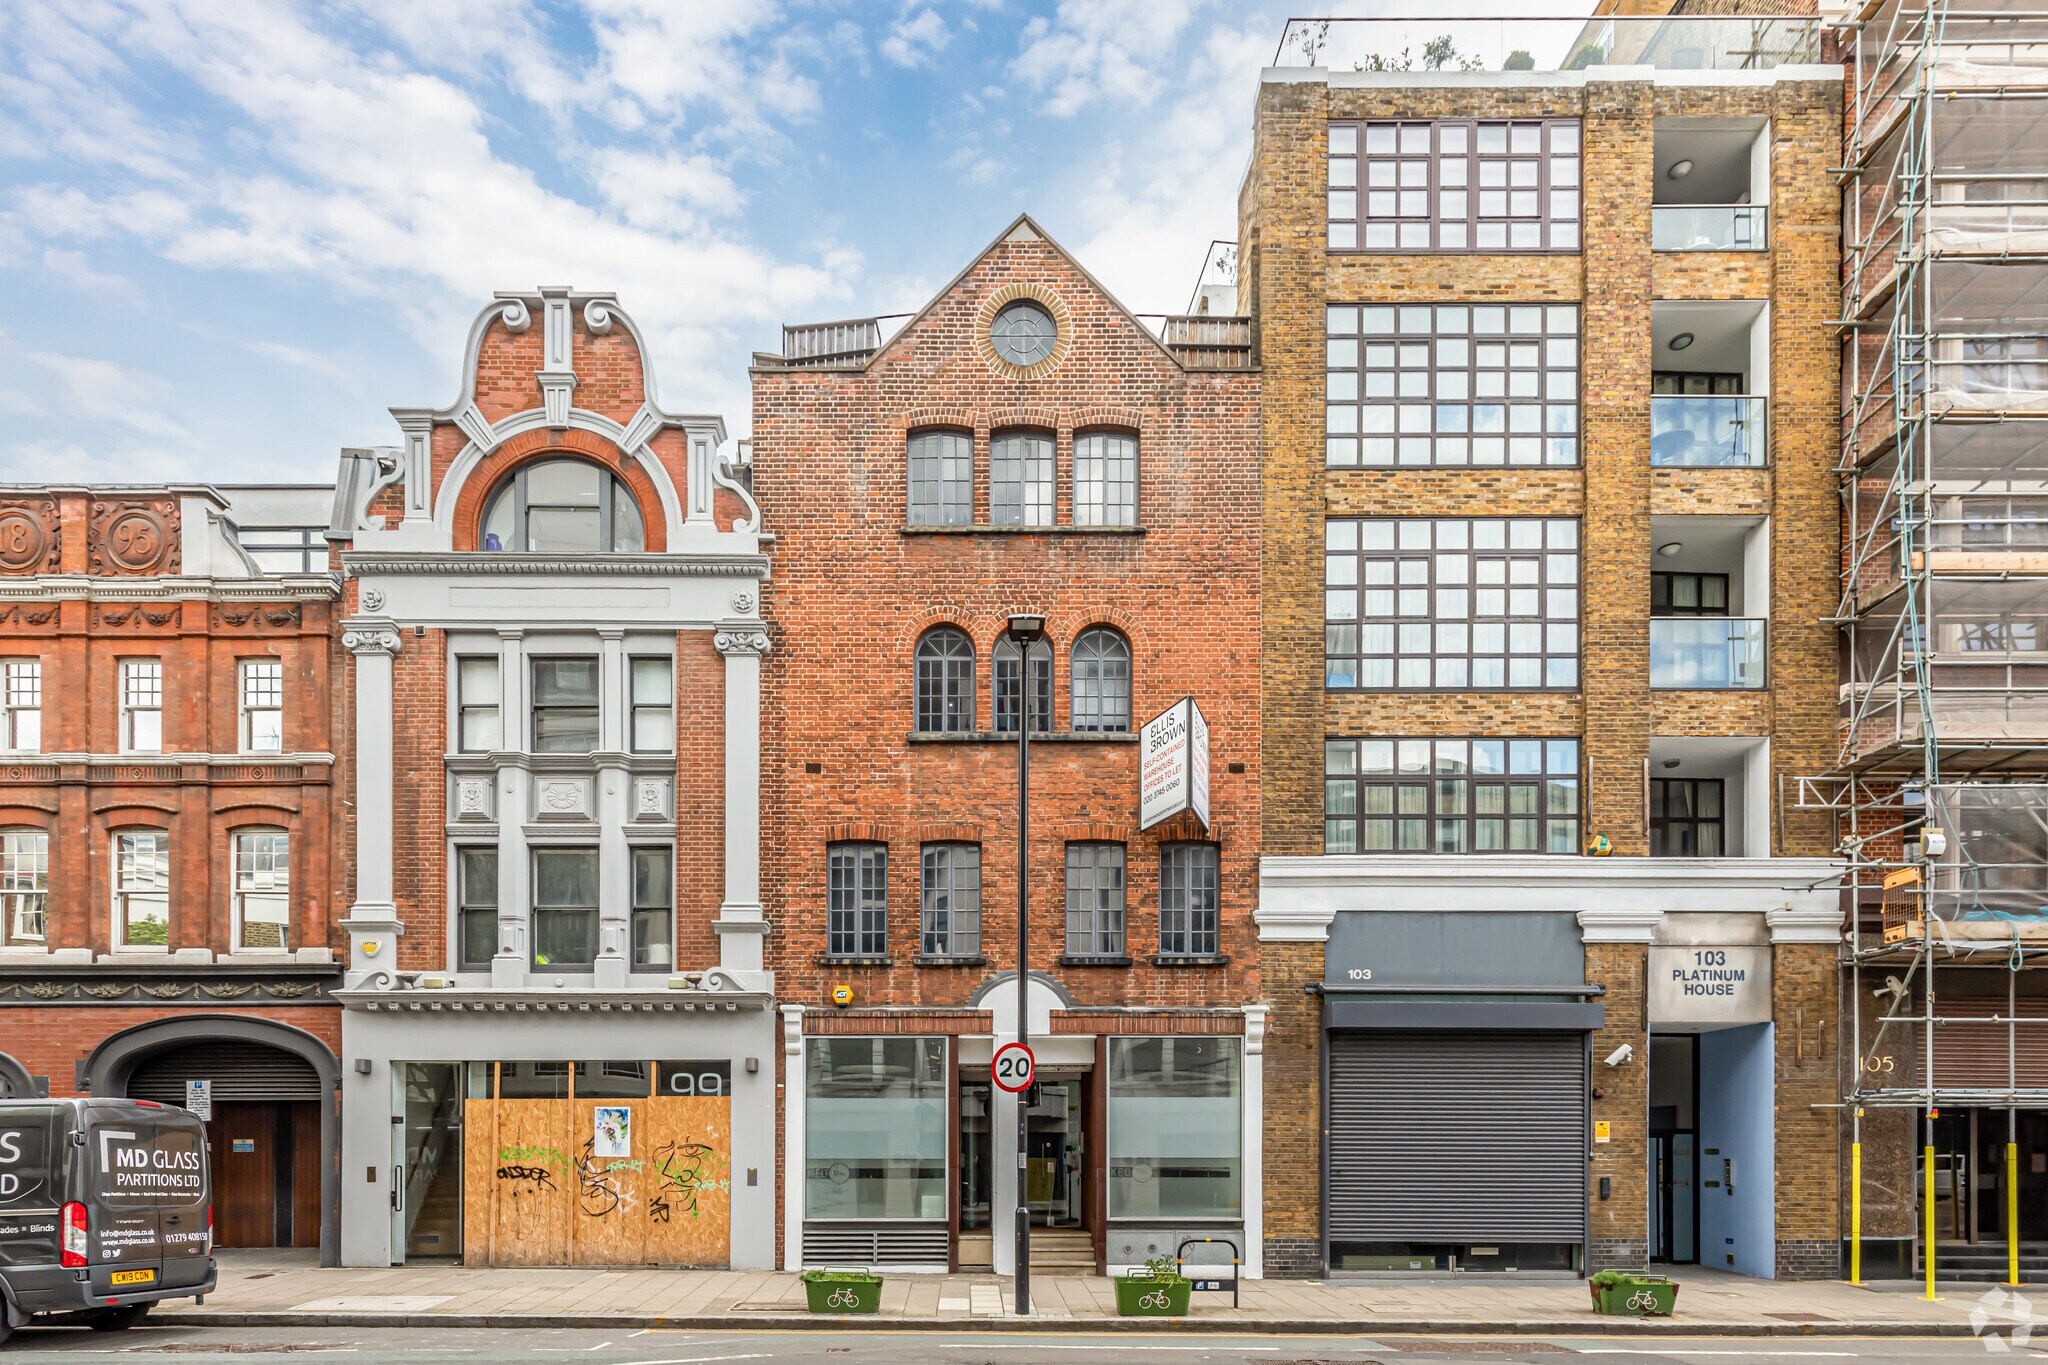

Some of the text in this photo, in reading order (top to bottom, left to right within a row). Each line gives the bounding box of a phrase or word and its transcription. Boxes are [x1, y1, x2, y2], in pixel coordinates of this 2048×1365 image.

[118, 525, 152, 554] 95
[1151, 712, 1175, 738] ELLIS
[1151, 720, 1186, 753] BROWN
[1144, 739, 1185, 770] SELF-CONTAINED
[1144, 757, 1174, 780] WAREHOUSE
[1144, 763, 1182, 792] OFFICES TO LET
[1695, 950, 1726, 966] 103
[1347, 969, 1372, 980] 103
[1673, 970, 1745, 981] PLATINUM
[1684, 984, 1734, 995] HOUSE
[999, 1057, 1030, 1078] 20
[671, 1072, 722, 1096] 99
[116, 1148, 200, 1170] MD GLASS
[117, 1173, 200, 1187] PARTITIONS LTD
[30, 1223, 55, 1233] Blinds
[100, 1229, 155, 1237] info@mdglass.co.uk
[101, 1237, 156, 1246] www.mdglass.co.uk
[165, 1233, 188, 1243] 01279
[134, 1271, 149, 1279] CDN
